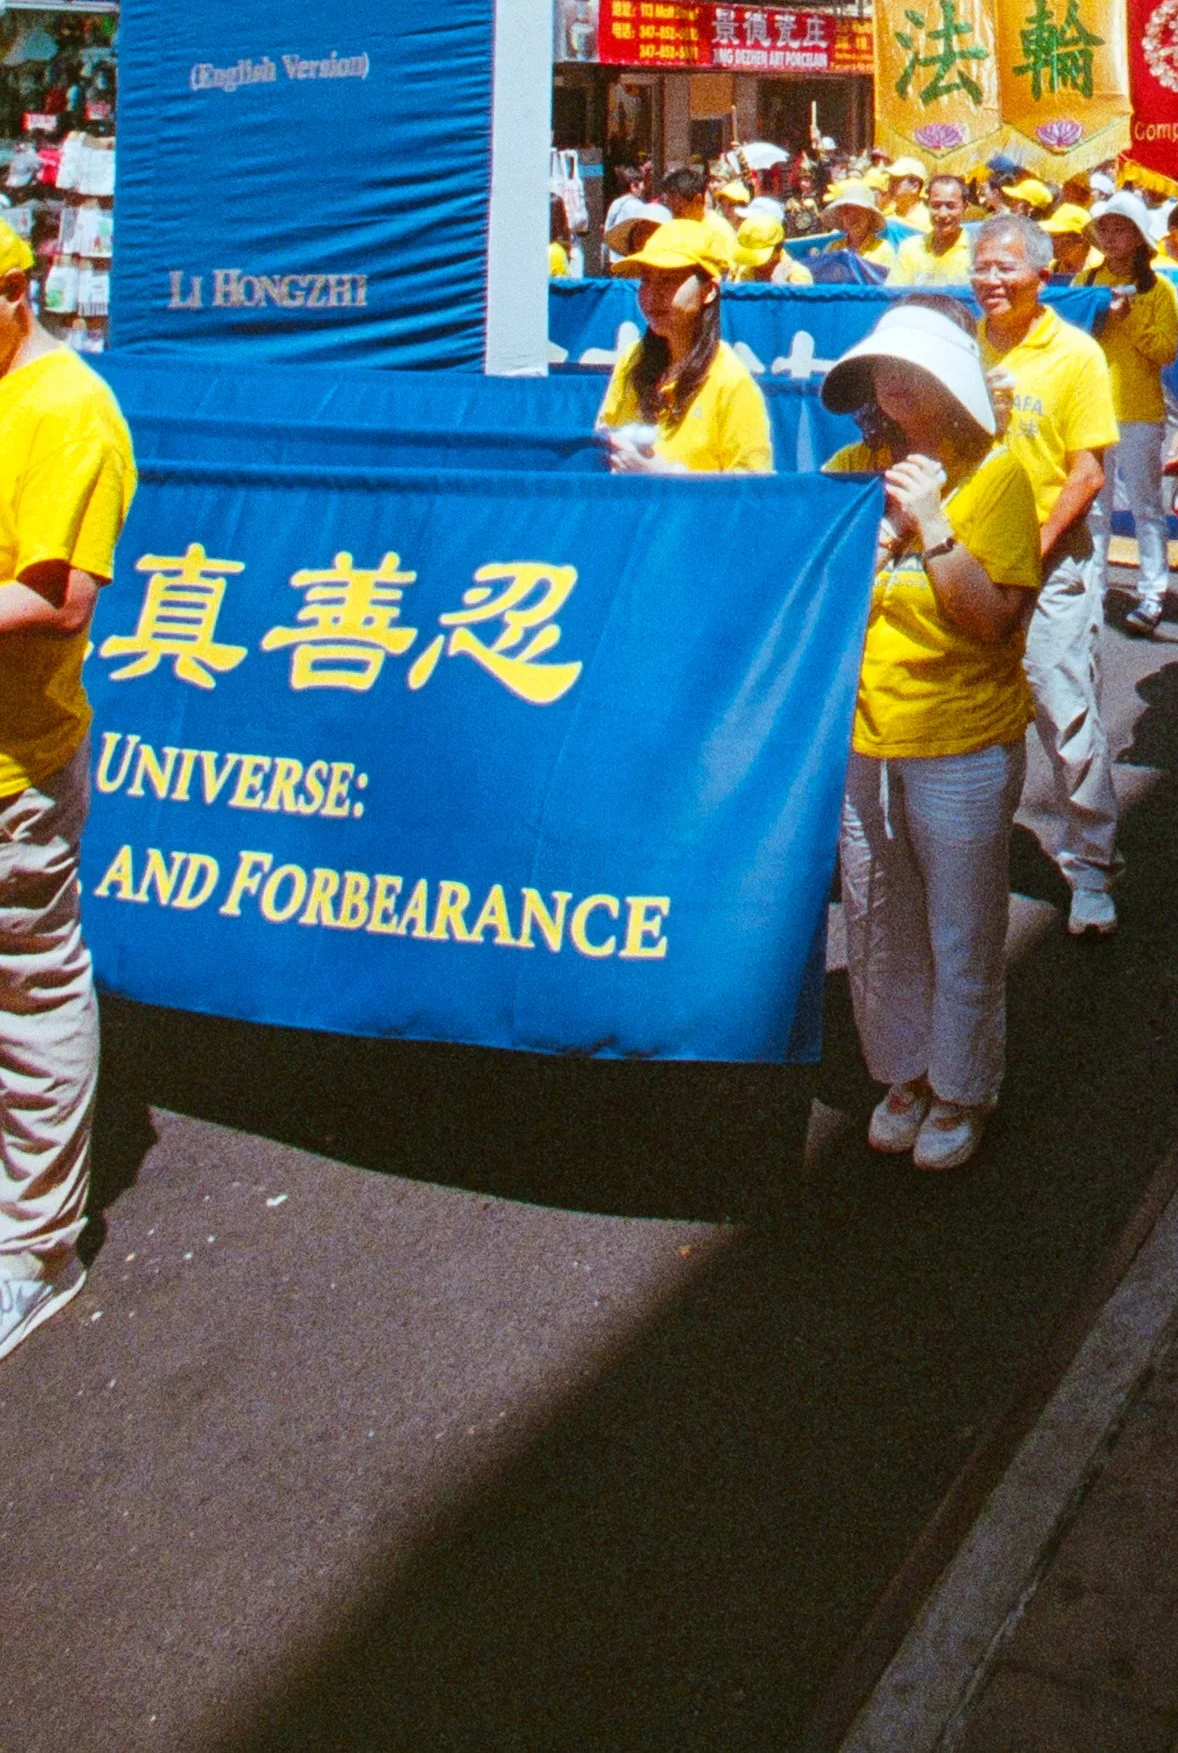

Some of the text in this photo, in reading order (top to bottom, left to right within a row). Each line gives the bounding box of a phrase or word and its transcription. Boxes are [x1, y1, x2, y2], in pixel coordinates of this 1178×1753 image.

[189, 50, 370, 92] (English Version)
[211, 268, 368, 308] HONGZHI
[98, 541, 584, 707] 真善忍
[95, 731, 369, 819] UNIVERSE:
[94, 844, 671, 960] AND FORBEARANCE
